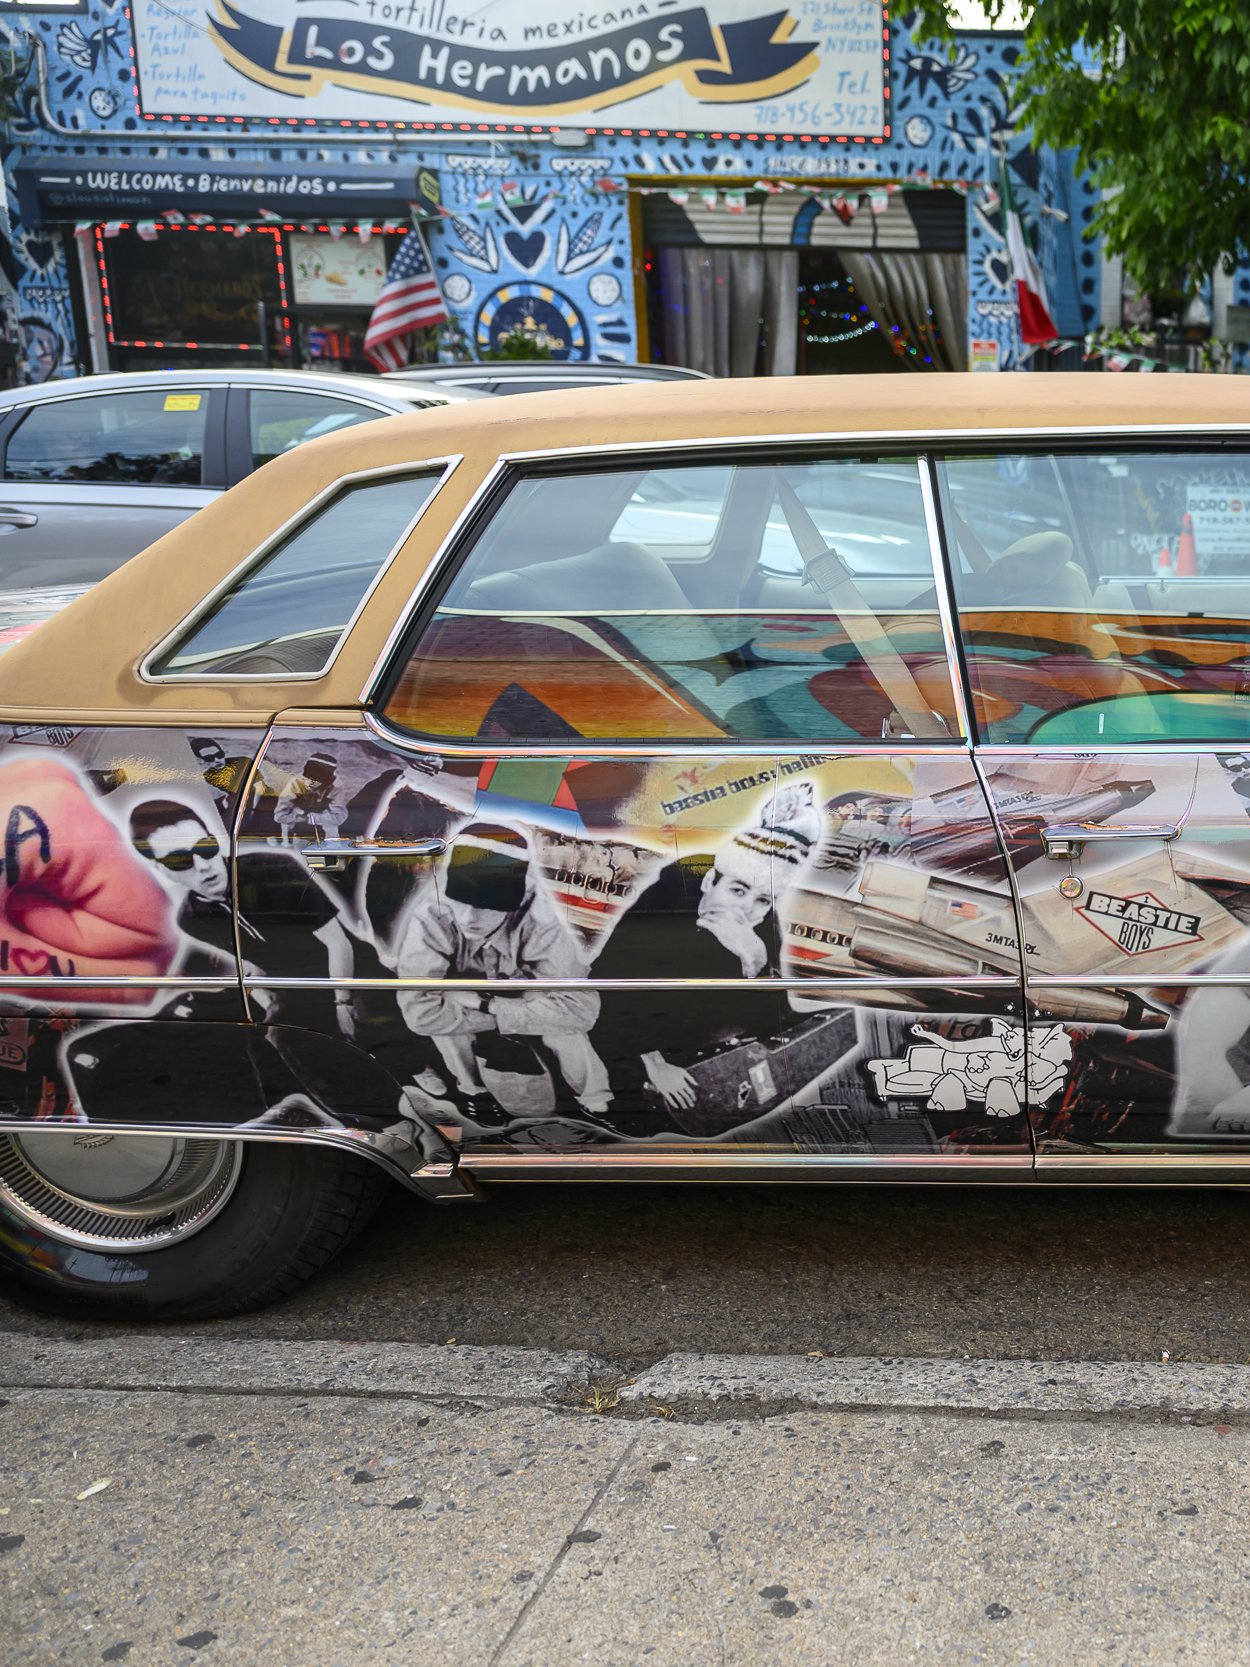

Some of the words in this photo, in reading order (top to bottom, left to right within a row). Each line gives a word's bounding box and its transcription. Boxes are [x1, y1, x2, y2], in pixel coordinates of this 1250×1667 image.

[365, 0, 507, 41] tortilleria
[523, 3, 649, 42] mexicana
[150, 41, 186, 57] Azul
[418, 22, 685, 97] Hermanos
[87, 172, 184, 191] WELCOME
[198, 173, 324, 195] Bienvenidos
[1089, 893, 1196, 934] BEASTIE
[1118, 920, 1154, 953] BOYS
